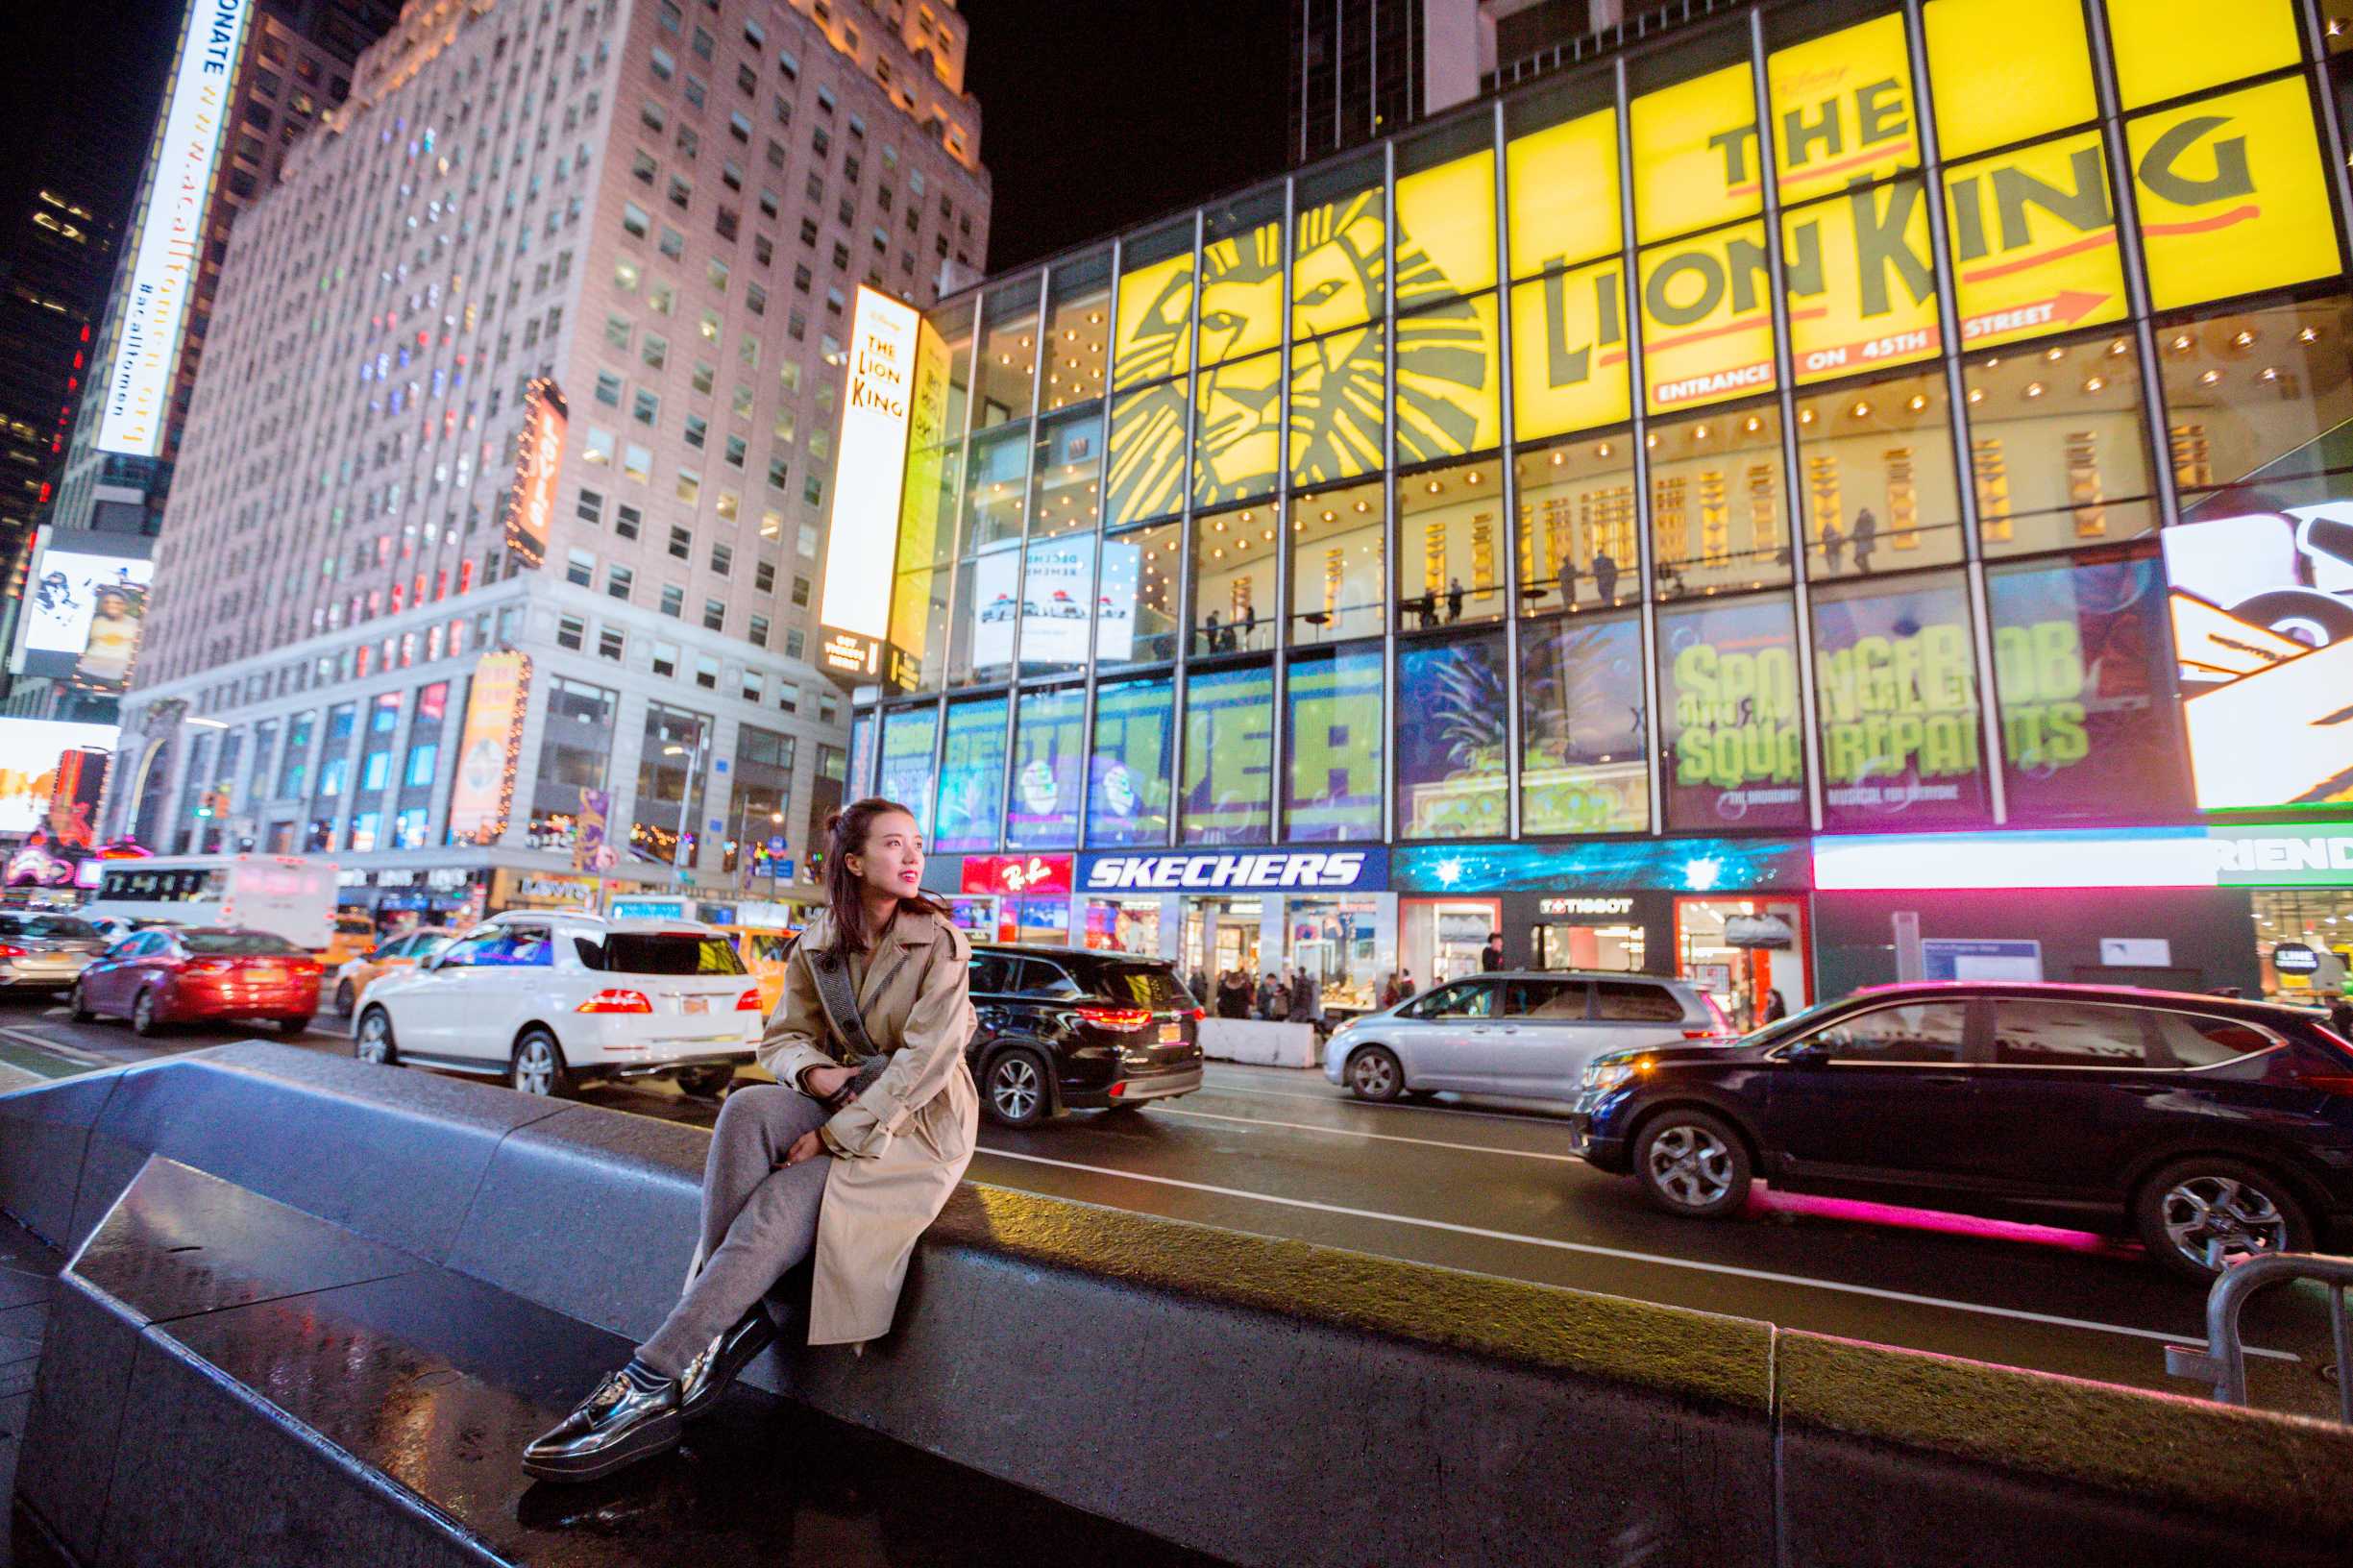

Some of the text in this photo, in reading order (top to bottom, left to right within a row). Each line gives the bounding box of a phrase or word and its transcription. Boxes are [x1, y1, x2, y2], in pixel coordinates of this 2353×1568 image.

[1708, 76, 1911, 184] THE
[1543, 116, 2256, 388] LION KING
[868, 334, 895, 358] THE
[1657, 303, 2055, 402] ENTRANCE ON 45TH STREET
[859, 350, 900, 384] LION
[852, 377, 902, 417] KING
[1088, 852, 1366, 889] SKECHERS
